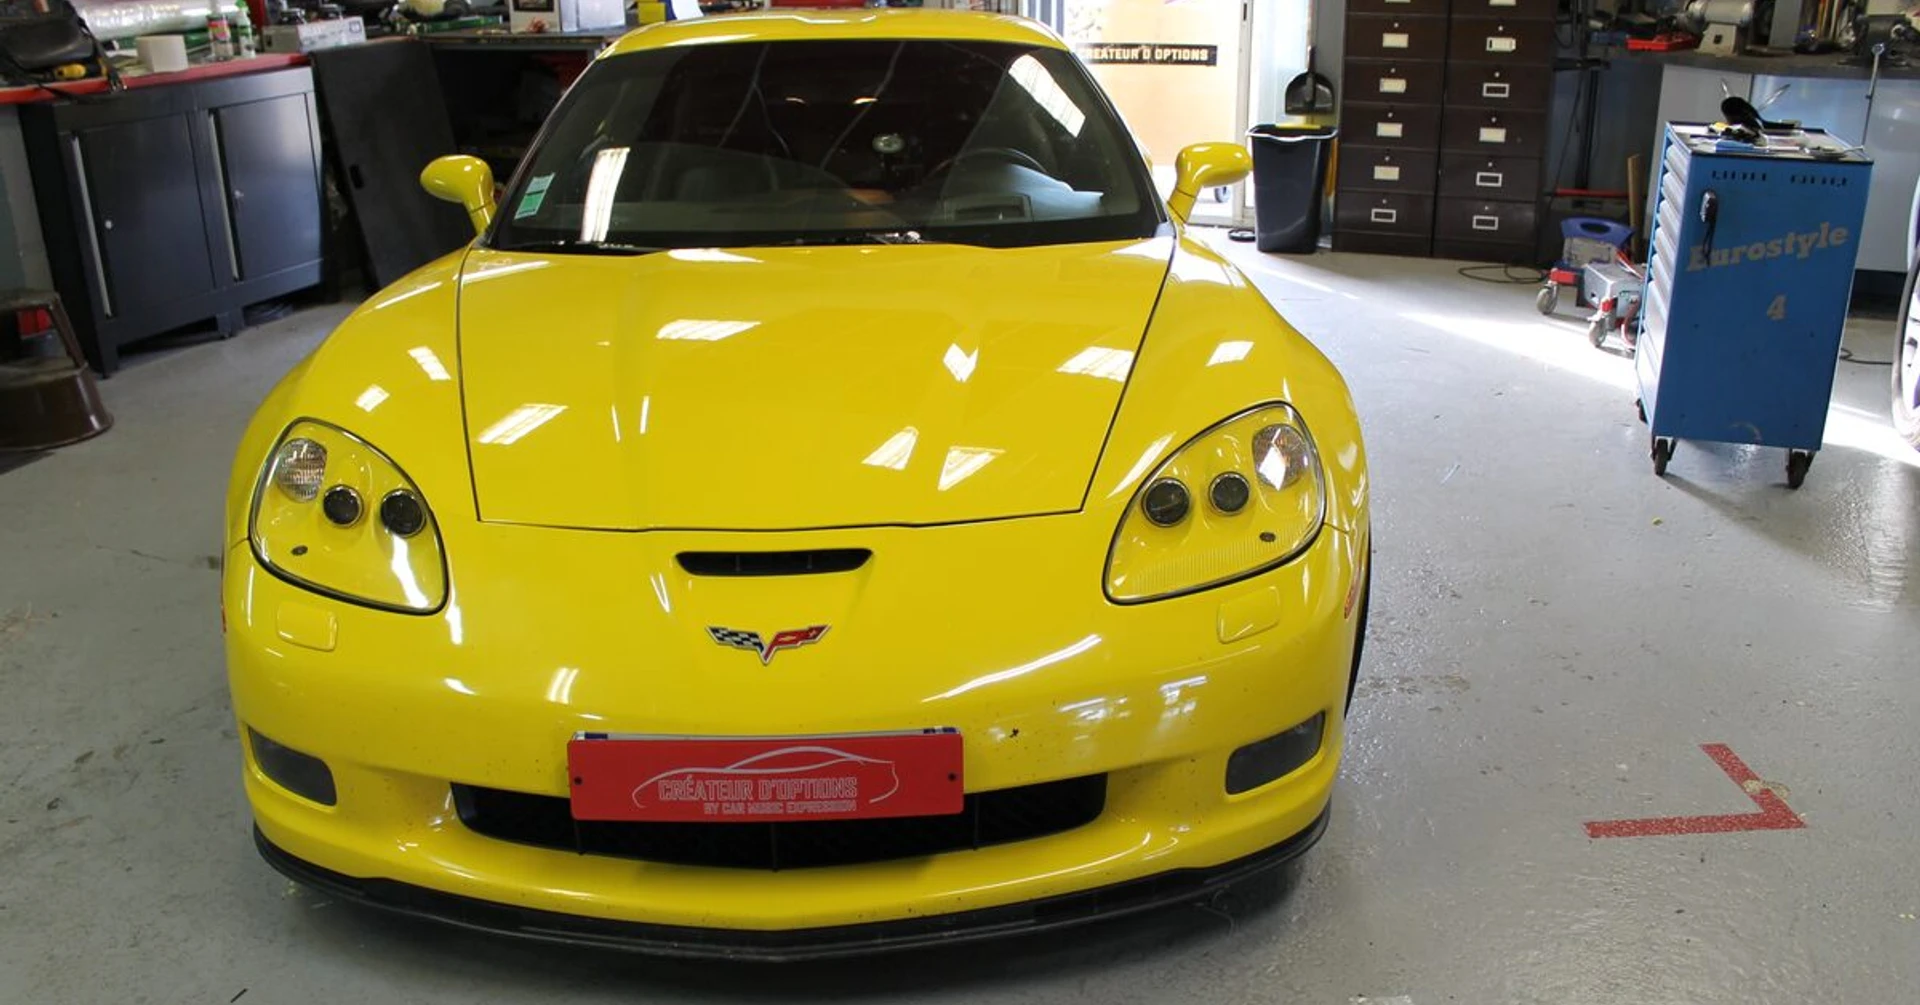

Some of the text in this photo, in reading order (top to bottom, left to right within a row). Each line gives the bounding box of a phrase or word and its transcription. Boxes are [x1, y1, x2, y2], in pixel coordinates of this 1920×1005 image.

[1687, 222, 1848, 272] Eurostyle
[1766, 294, 1787, 321] 4
[658, 775, 858, 801] CRÉATEUR D'OPTIONS
[722, 802, 745, 814] CAR
